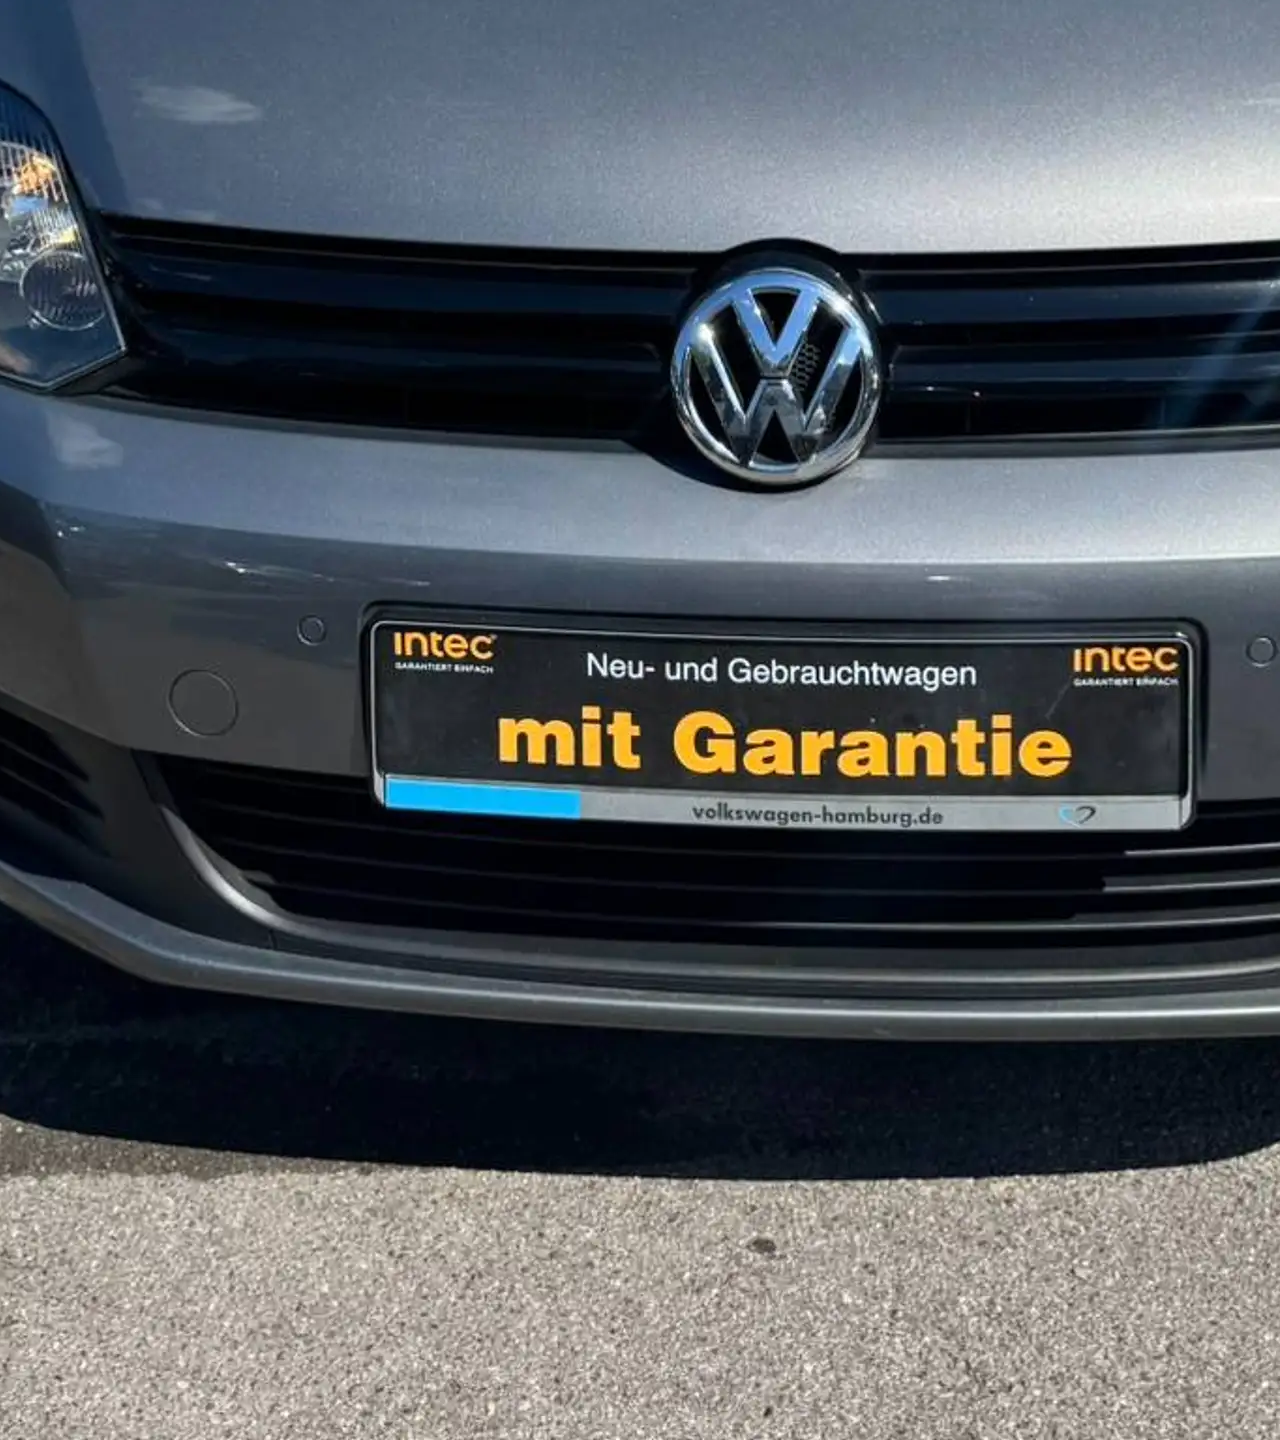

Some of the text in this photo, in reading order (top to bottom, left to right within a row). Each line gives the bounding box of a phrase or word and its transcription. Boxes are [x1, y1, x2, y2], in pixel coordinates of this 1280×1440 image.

[586, 652, 977, 692] Neu- und Gebrauchtwagen
[498, 705, 1072, 778] mit Garantie
[692, 804, 945, 827] volkswagen-hamburg.de
